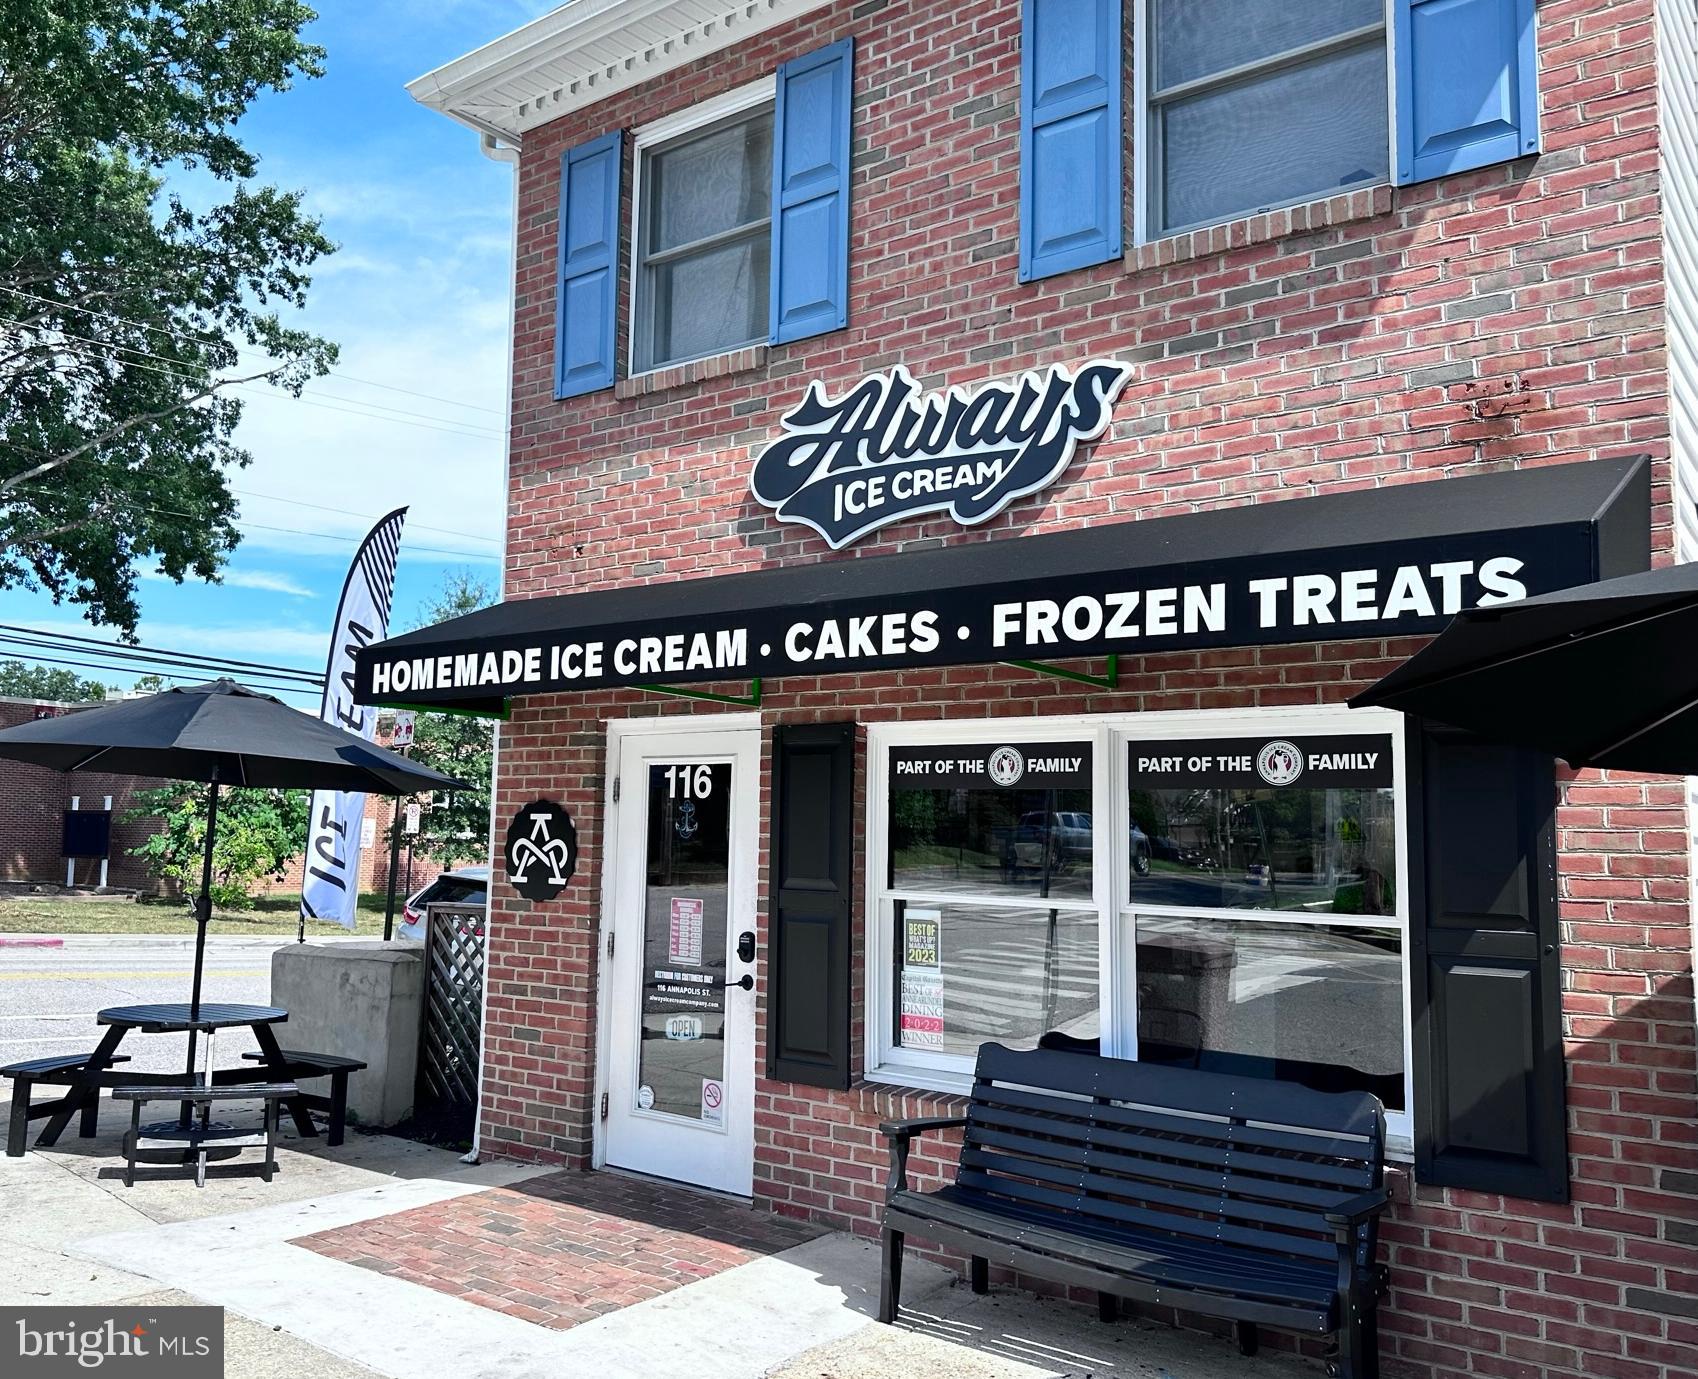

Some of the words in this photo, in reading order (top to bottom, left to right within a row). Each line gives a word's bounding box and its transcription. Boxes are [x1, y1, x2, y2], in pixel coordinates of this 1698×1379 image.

[753, 366, 1124, 511] Always
[833, 475, 887, 522] ICE
[891, 458, 1004, 500] CREAM
[371, 647, 542, 694] HOMEMADE
[551, 642, 603, 680] ICE
[614, 628, 748, 675] CREAM
[784, 610, 940, 663] CAKES
[992, 583, 1227, 648] FROZEN
[1249, 556, 1527, 629] TREATS
[897, 760, 932, 775] PART
[935, 759, 955, 774] OF
[957, 759, 984, 774] THE
[1027, 757, 1083, 773] FAMILY
[1138, 757, 1183, 772] PART
[1187, 756, 1212, 772] OF
[1216, 756, 1252, 772] THE
[1308, 753, 1379, 770] FAMILY
[664, 764, 712, 799] 116
[908, 923, 926, 936] BEST
[926, 924, 936, 937] OF
[908, 949, 936, 963] 2023
[657, 984, 666, 992] 116
[667, 985, 700, 995] ANNAPOLIS
[701, 988, 711, 997] ST.
[902, 983, 925, 995] BEST
[902, 1003, 943, 1017] DINING
[672, 1020, 695, 1036] OPEN
[901, 1030, 943, 1046] WINNER
